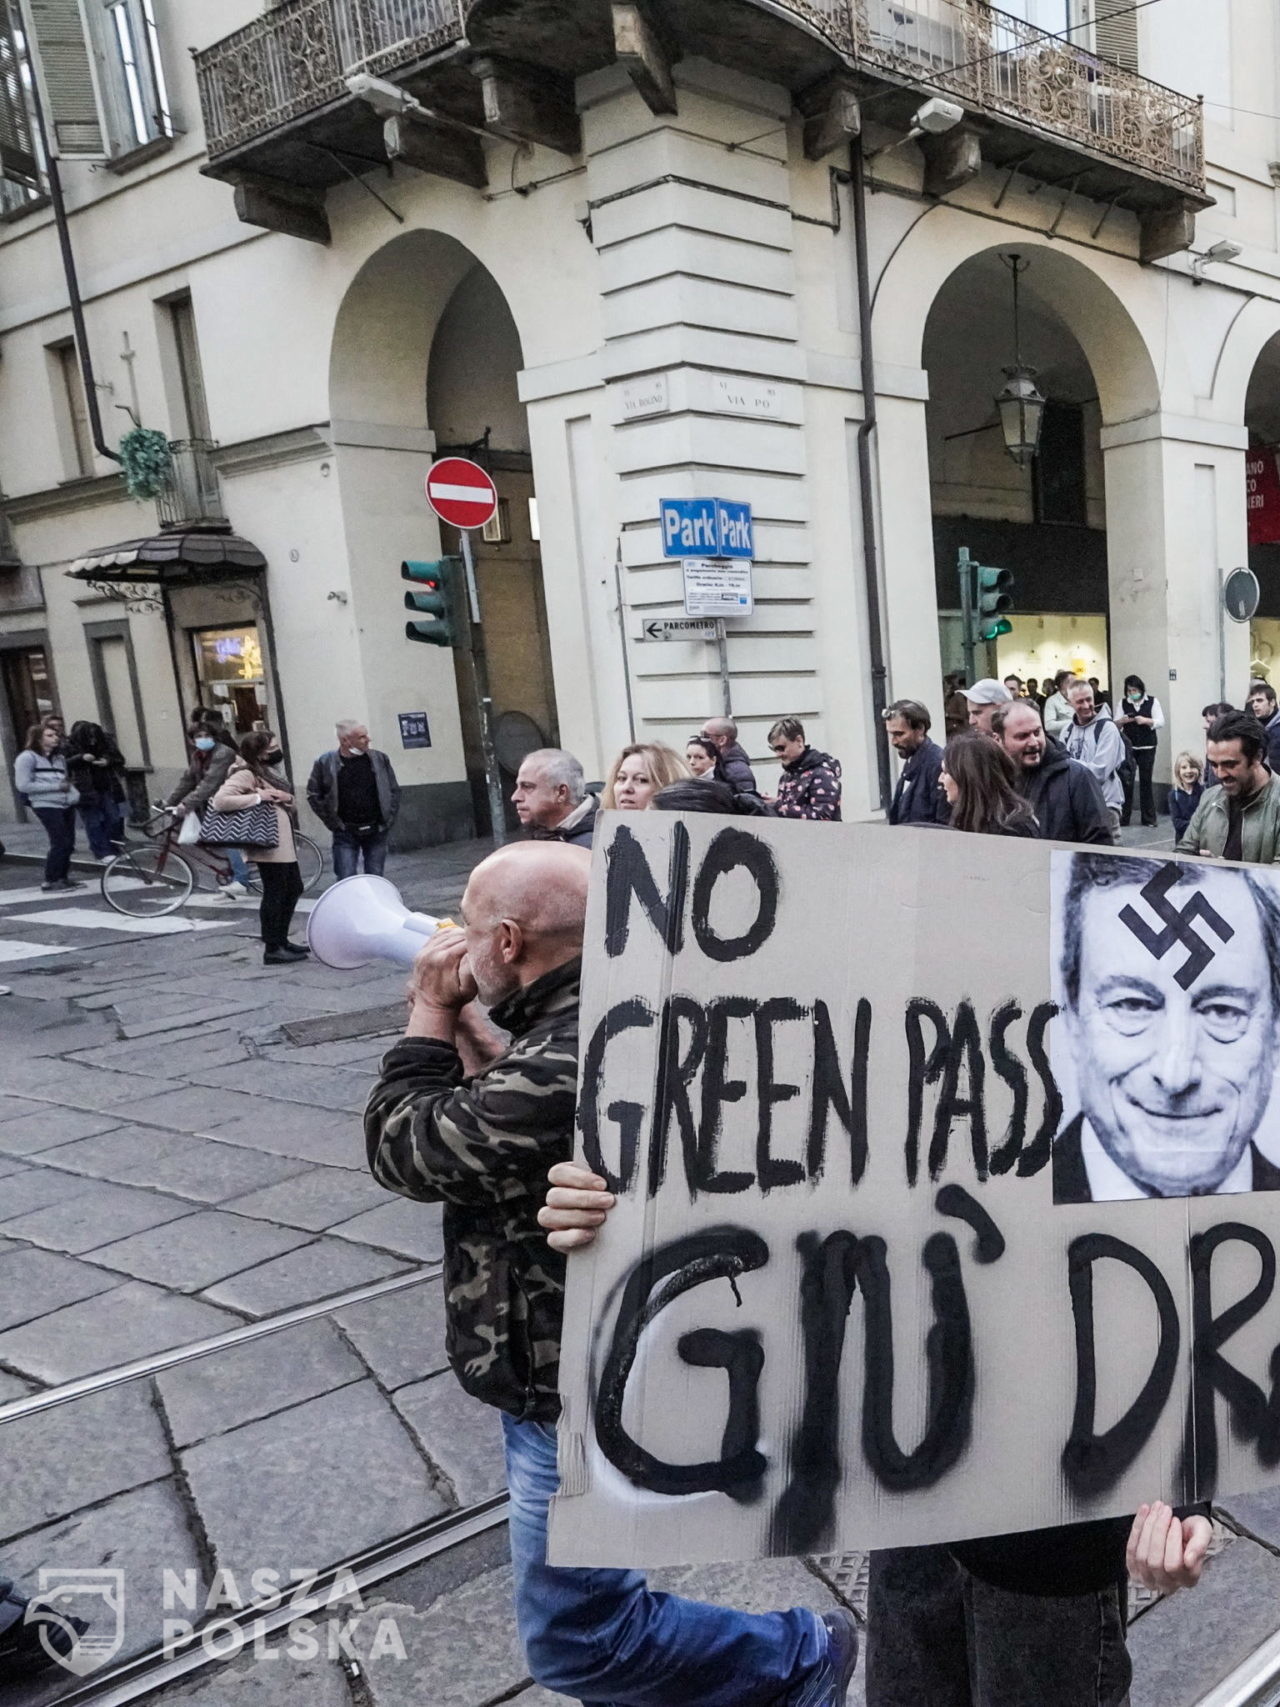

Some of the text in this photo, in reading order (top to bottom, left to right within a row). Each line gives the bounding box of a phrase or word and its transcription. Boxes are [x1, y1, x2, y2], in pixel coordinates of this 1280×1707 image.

[727, 395, 770, 409] VIA PO
[664, 508, 716, 547] Park
[720, 508, 752, 549] Park
[664, 621, 715, 630] PARCOMETRO
[604, 820, 778, 962] NO
[576, 996, 1064, 1203] GREEN PASS
